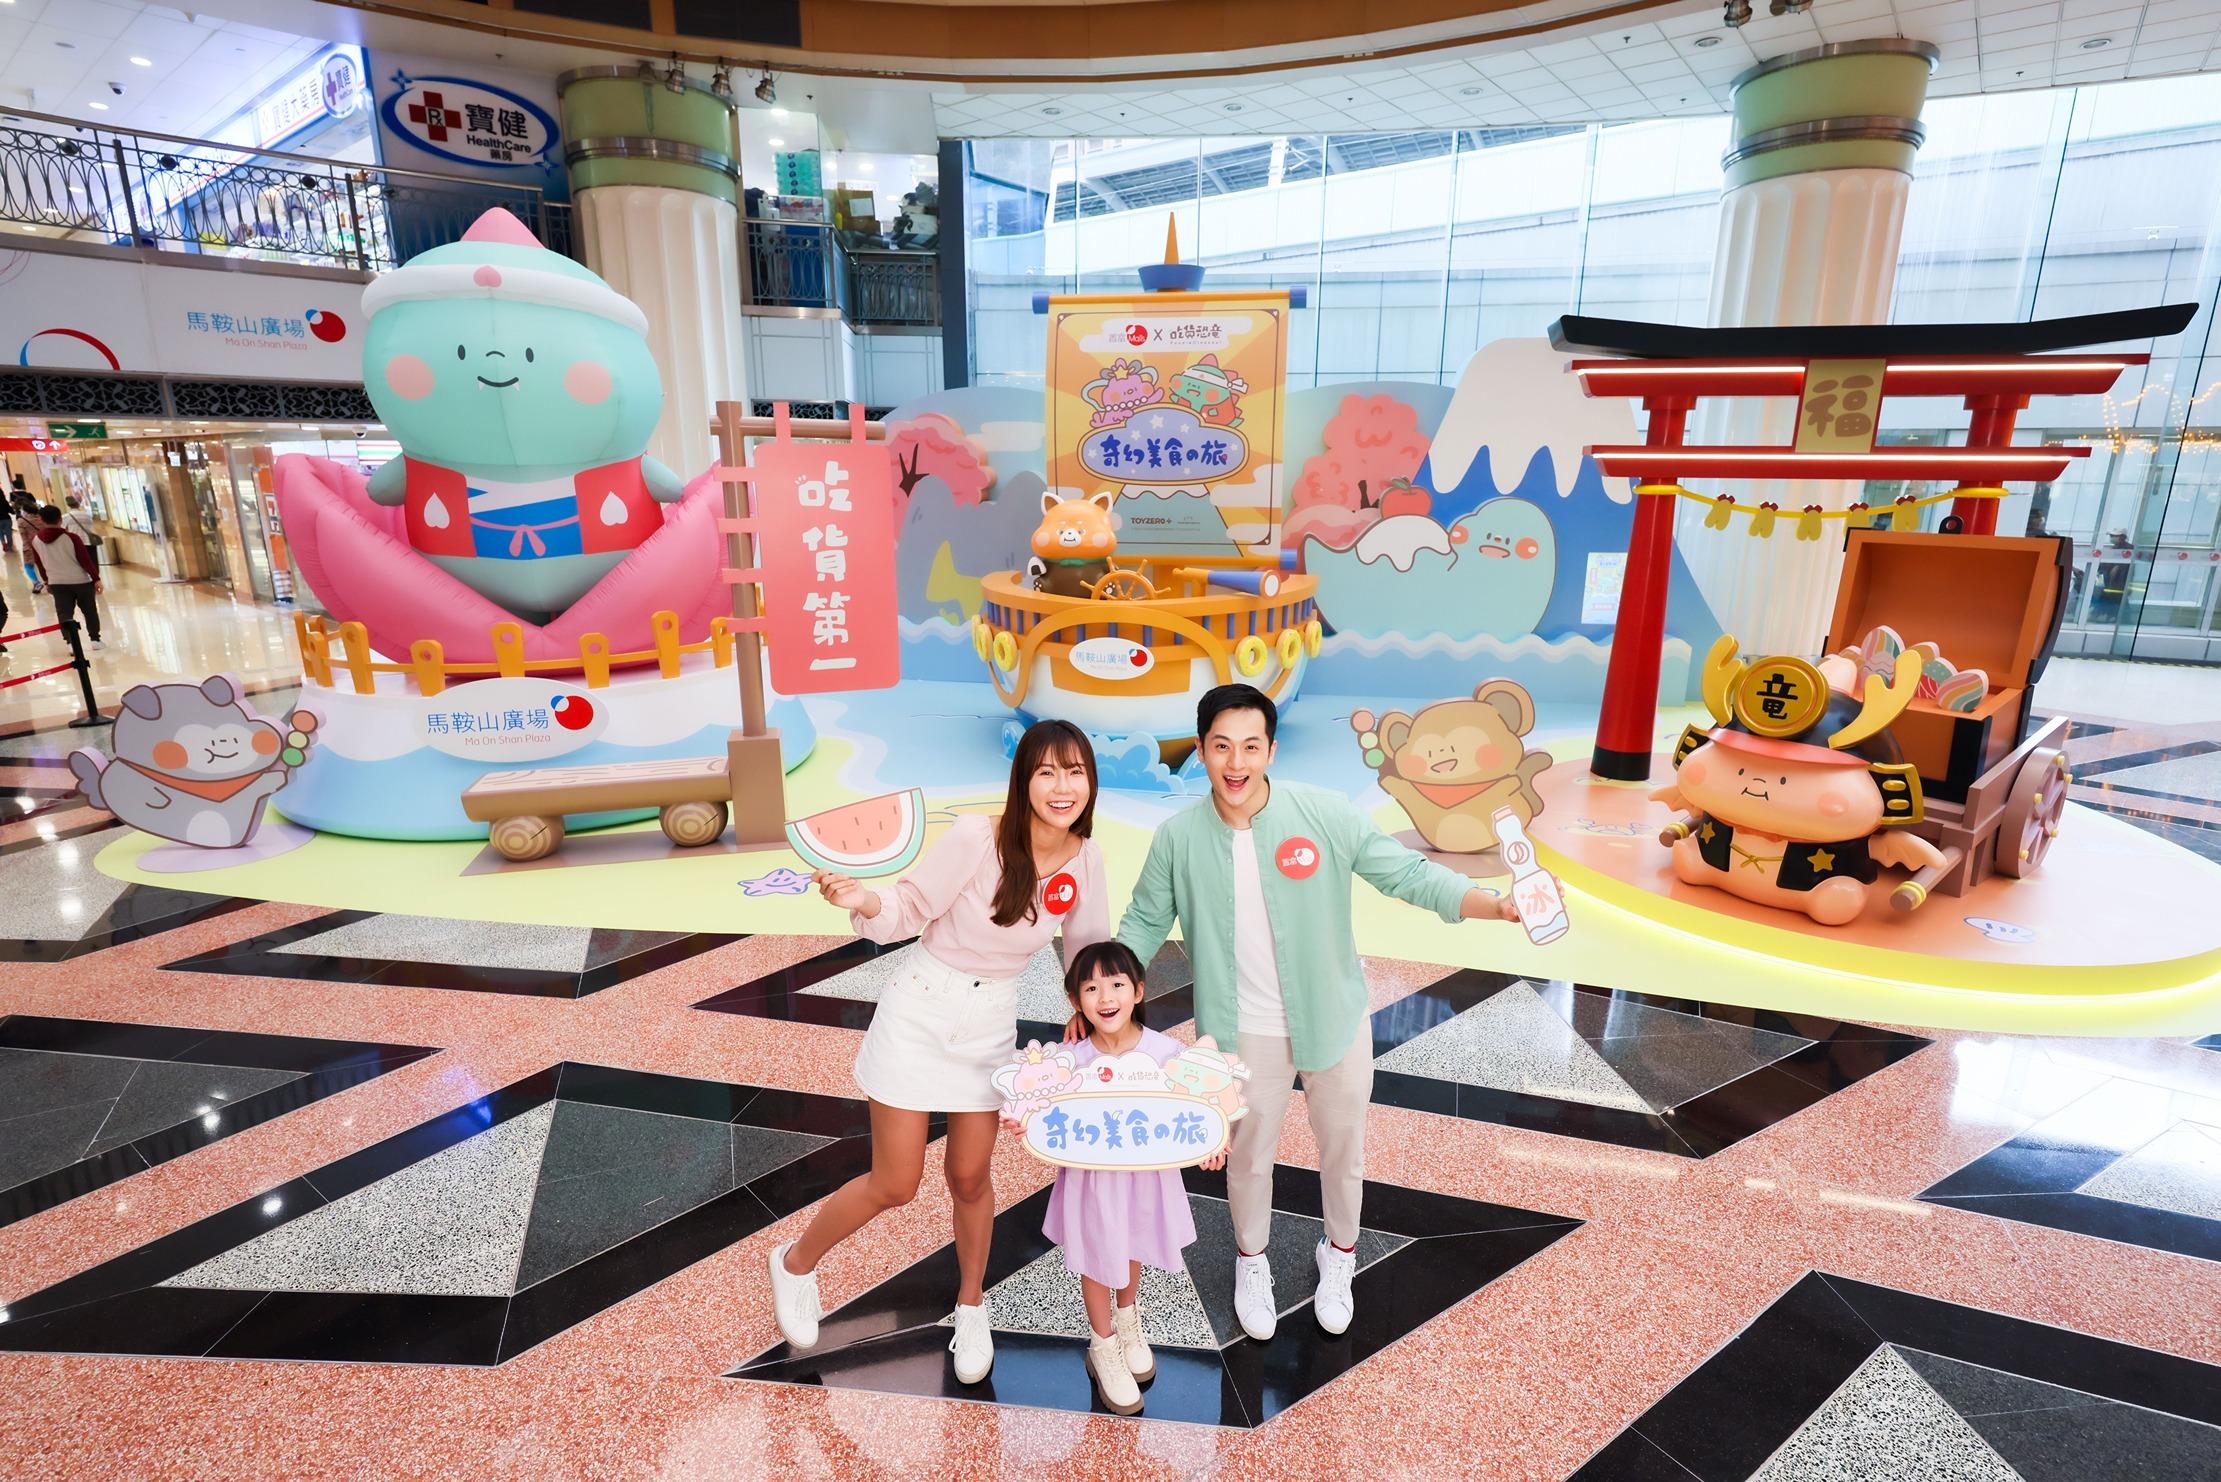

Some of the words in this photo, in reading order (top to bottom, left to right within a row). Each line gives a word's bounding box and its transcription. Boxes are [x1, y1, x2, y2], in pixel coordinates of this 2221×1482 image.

[465, 104, 529, 139] 寶健
[466, 135, 532, 154] HealthCare
[186, 311, 306, 339] 馬鞍山廣場
[225, 337, 240, 347] Ma
[242, 338, 256, 348] On
[258, 338, 282, 349] Shan
[283, 340, 308, 351] Plaza
[1804, 374, 1875, 438] 福
[1100, 434, 1228, 469] 奇幻美食の旅
[798, 460, 857, 671] 吃貨第一
[1756, 673, 1799, 720] 竜
[427, 708, 549, 735] 馬鞍山廣場
[465, 736, 480, 746] Ma
[483, 736, 496, 745] On
[499, 734, 523, 744] Shan
[525, 733, 551, 743] Plaza
[1042, 1106, 1208, 1150] 奇幻美食の旅
